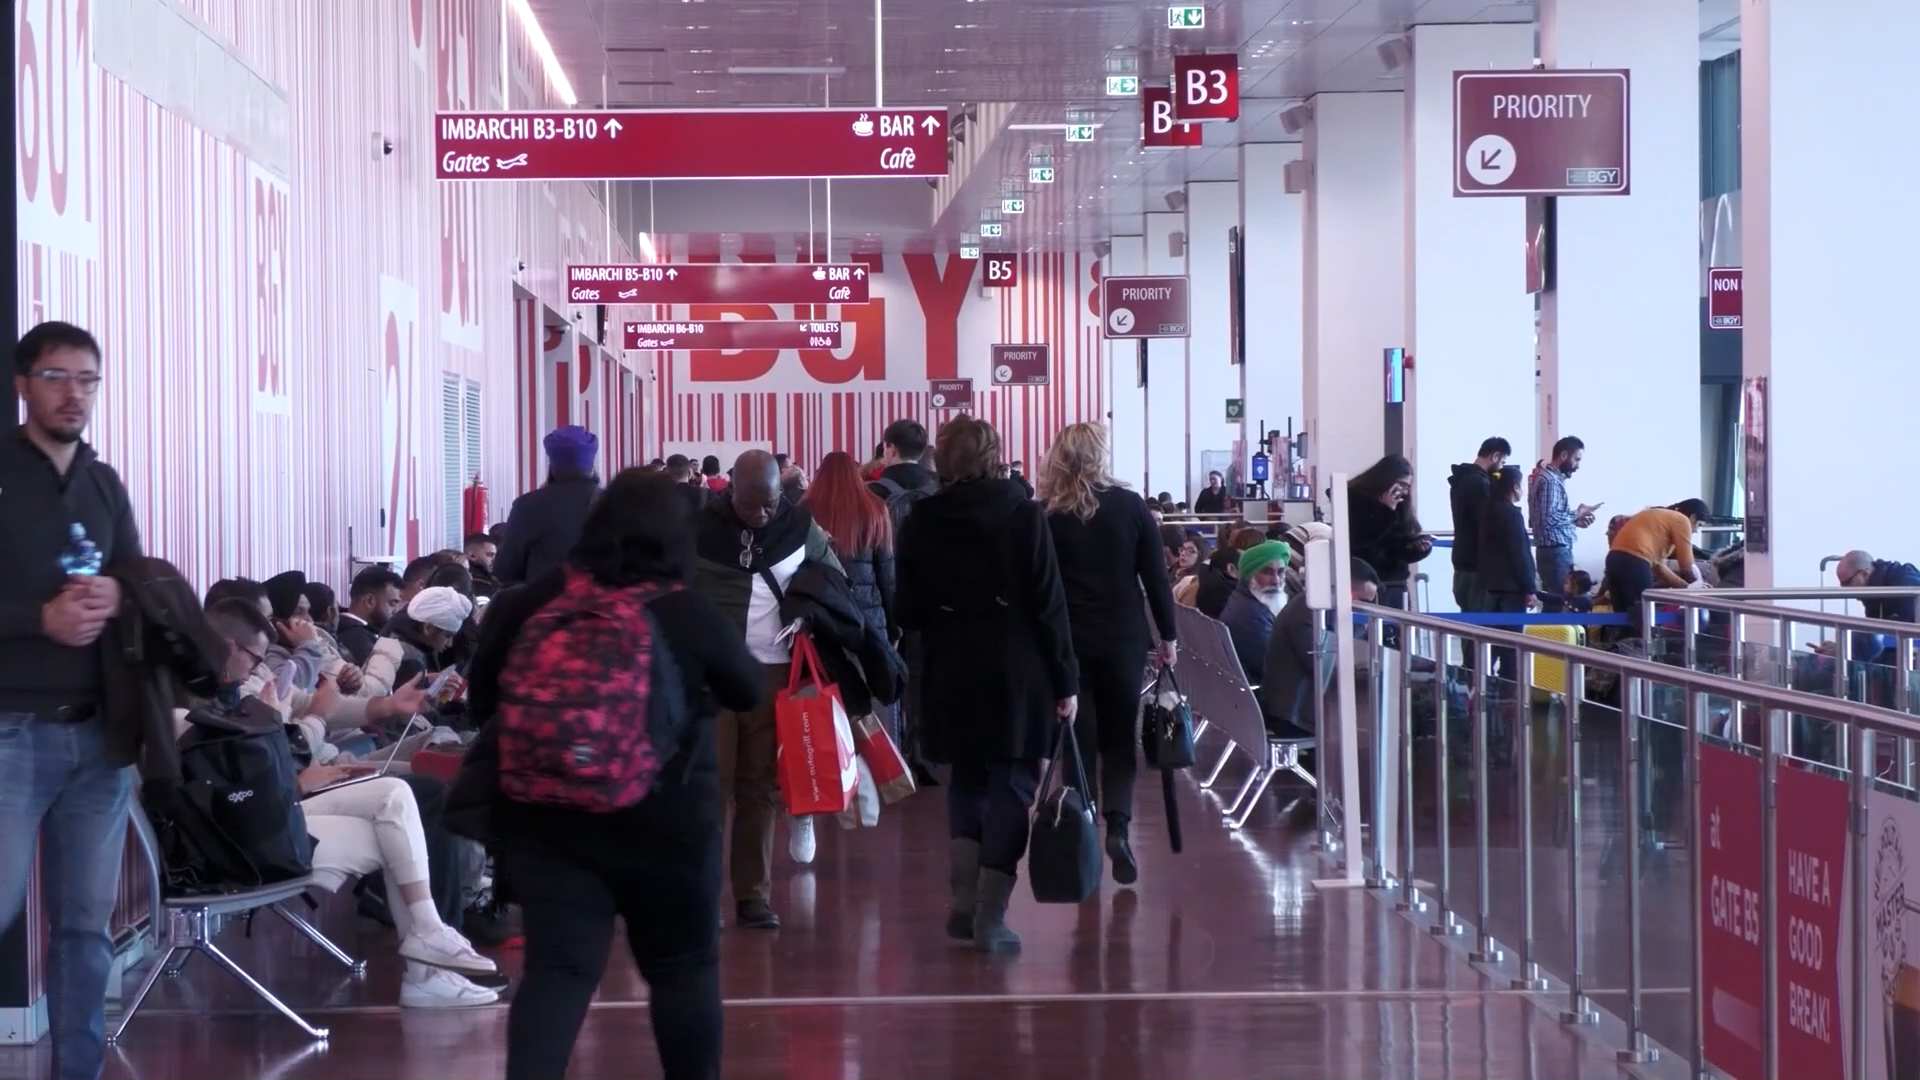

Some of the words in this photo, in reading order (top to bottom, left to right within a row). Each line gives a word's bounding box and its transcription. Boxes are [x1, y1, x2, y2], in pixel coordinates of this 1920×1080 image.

[1187, 69, 1228, 104] B3
[1493, 94, 1592, 118] PRIORITY
[442, 117, 528, 140] IMBARCHI
[533, 117, 597, 139] B3-B10
[880, 115, 915, 136] BAR
[442, 151, 490, 173] Gates
[1587, 170, 1616, 183] BGY
[571, 268, 622, 281] IMBARCHI
[625, 268, 663, 281] B5-B10
[829, 268, 850, 281] BAR
[989, 261, 1012, 280] B5
[571, 287, 600, 300] Gates
[1122, 287, 1172, 300] PRIORITY
[1713, 278, 1738, 291] NON
[637, 324, 675, 334] IMBARCHI
[676, 323, 704, 334] B6-B10
[810, 323, 839, 333] TOILETS
[637, 338, 658, 348] Gates
[1004, 351, 1037, 361] PRIORITY
[1710, 806, 1721, 850] at
[1788, 849, 1819, 904] HAVE
[1821, 861, 1831, 908] A
[1711, 875, 1741, 937] GATE
[1744, 889, 1759, 946] B5
[1788, 915, 1823, 971] GOOD
[1789, 981, 1831, 1044] BREAK!
